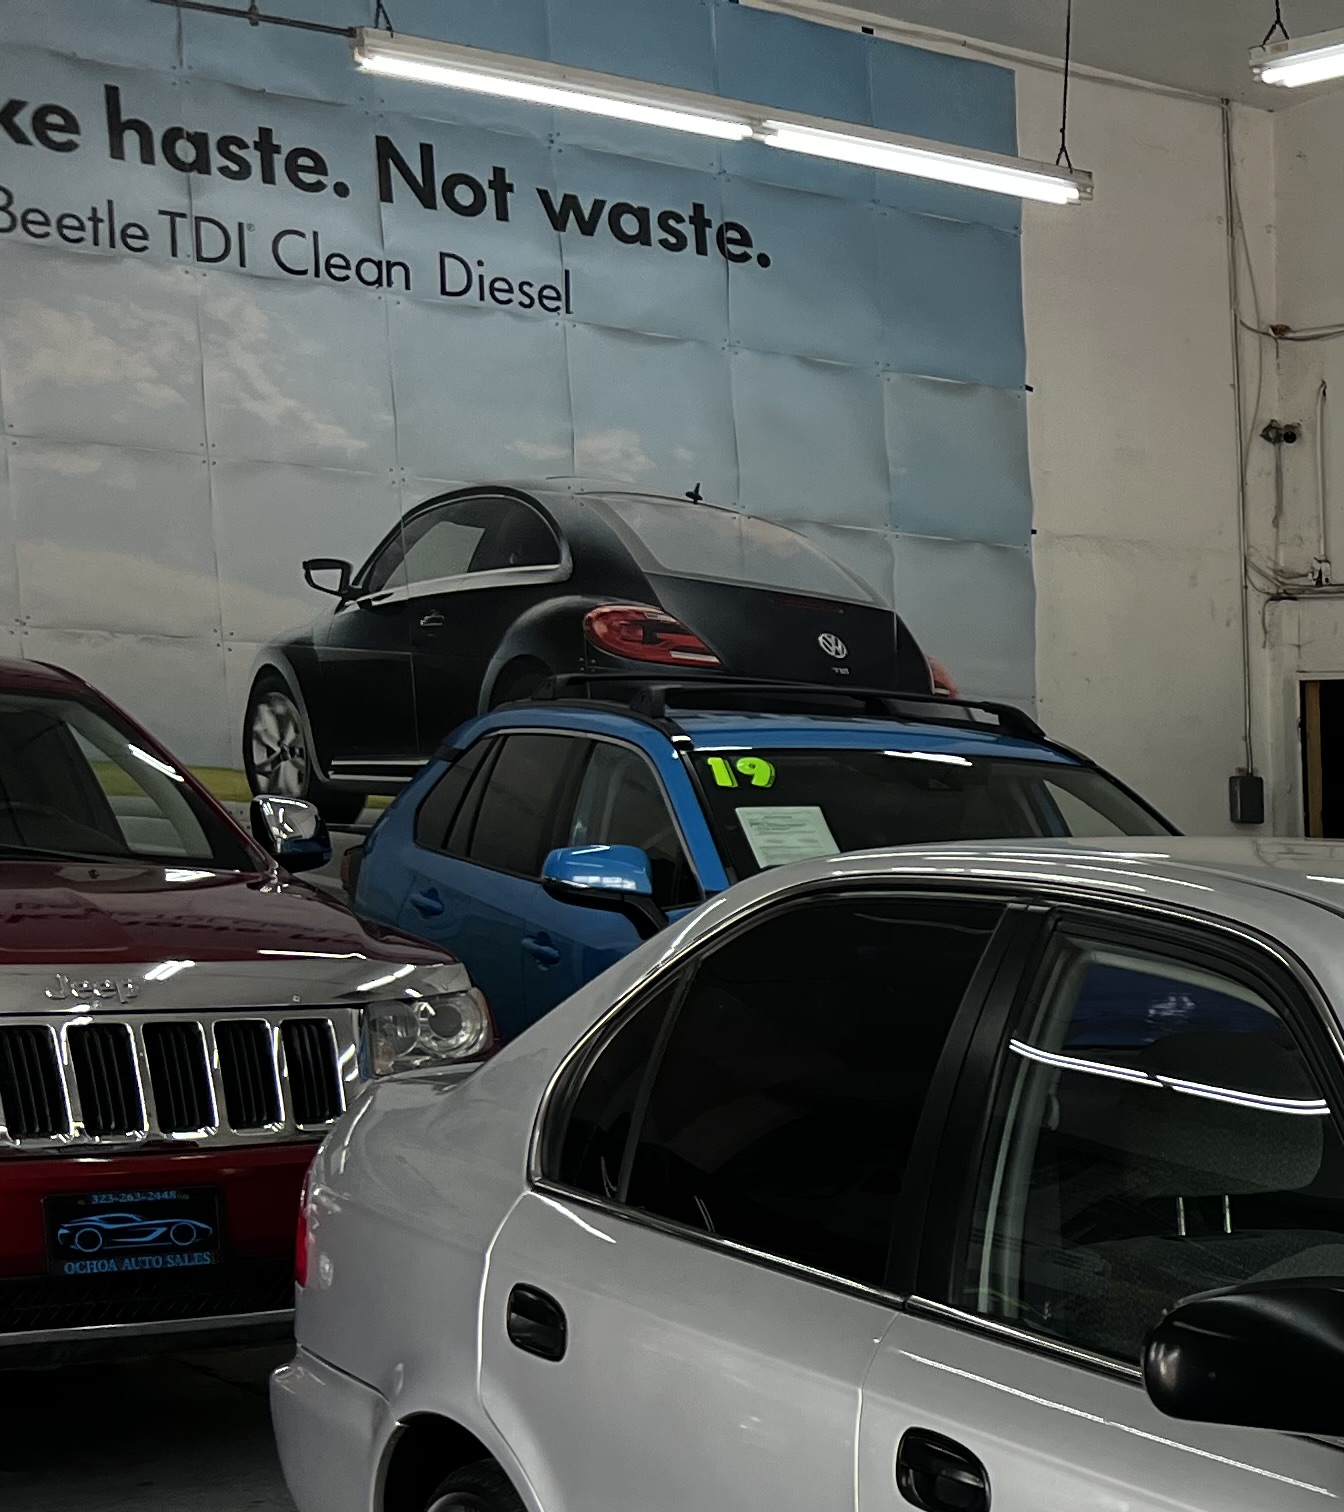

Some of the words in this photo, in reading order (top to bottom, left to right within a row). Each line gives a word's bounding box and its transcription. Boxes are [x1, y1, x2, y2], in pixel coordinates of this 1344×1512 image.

[104, 84, 350, 199] haste.
[375, 135, 514, 223] Not
[536, 187, 771, 269] waste.
[0, 185, 149, 253] Beetle
[272, 229, 411, 291] Clean
[439, 251, 574, 315] Diesel
[707, 757, 775, 788] 19
[45, 973, 139, 1005] Jeep
[64, 1258, 118, 1274] OCHOA
[121, 1254, 163, 1271] AUTO
[167, 1251, 211, 1267] SALES
